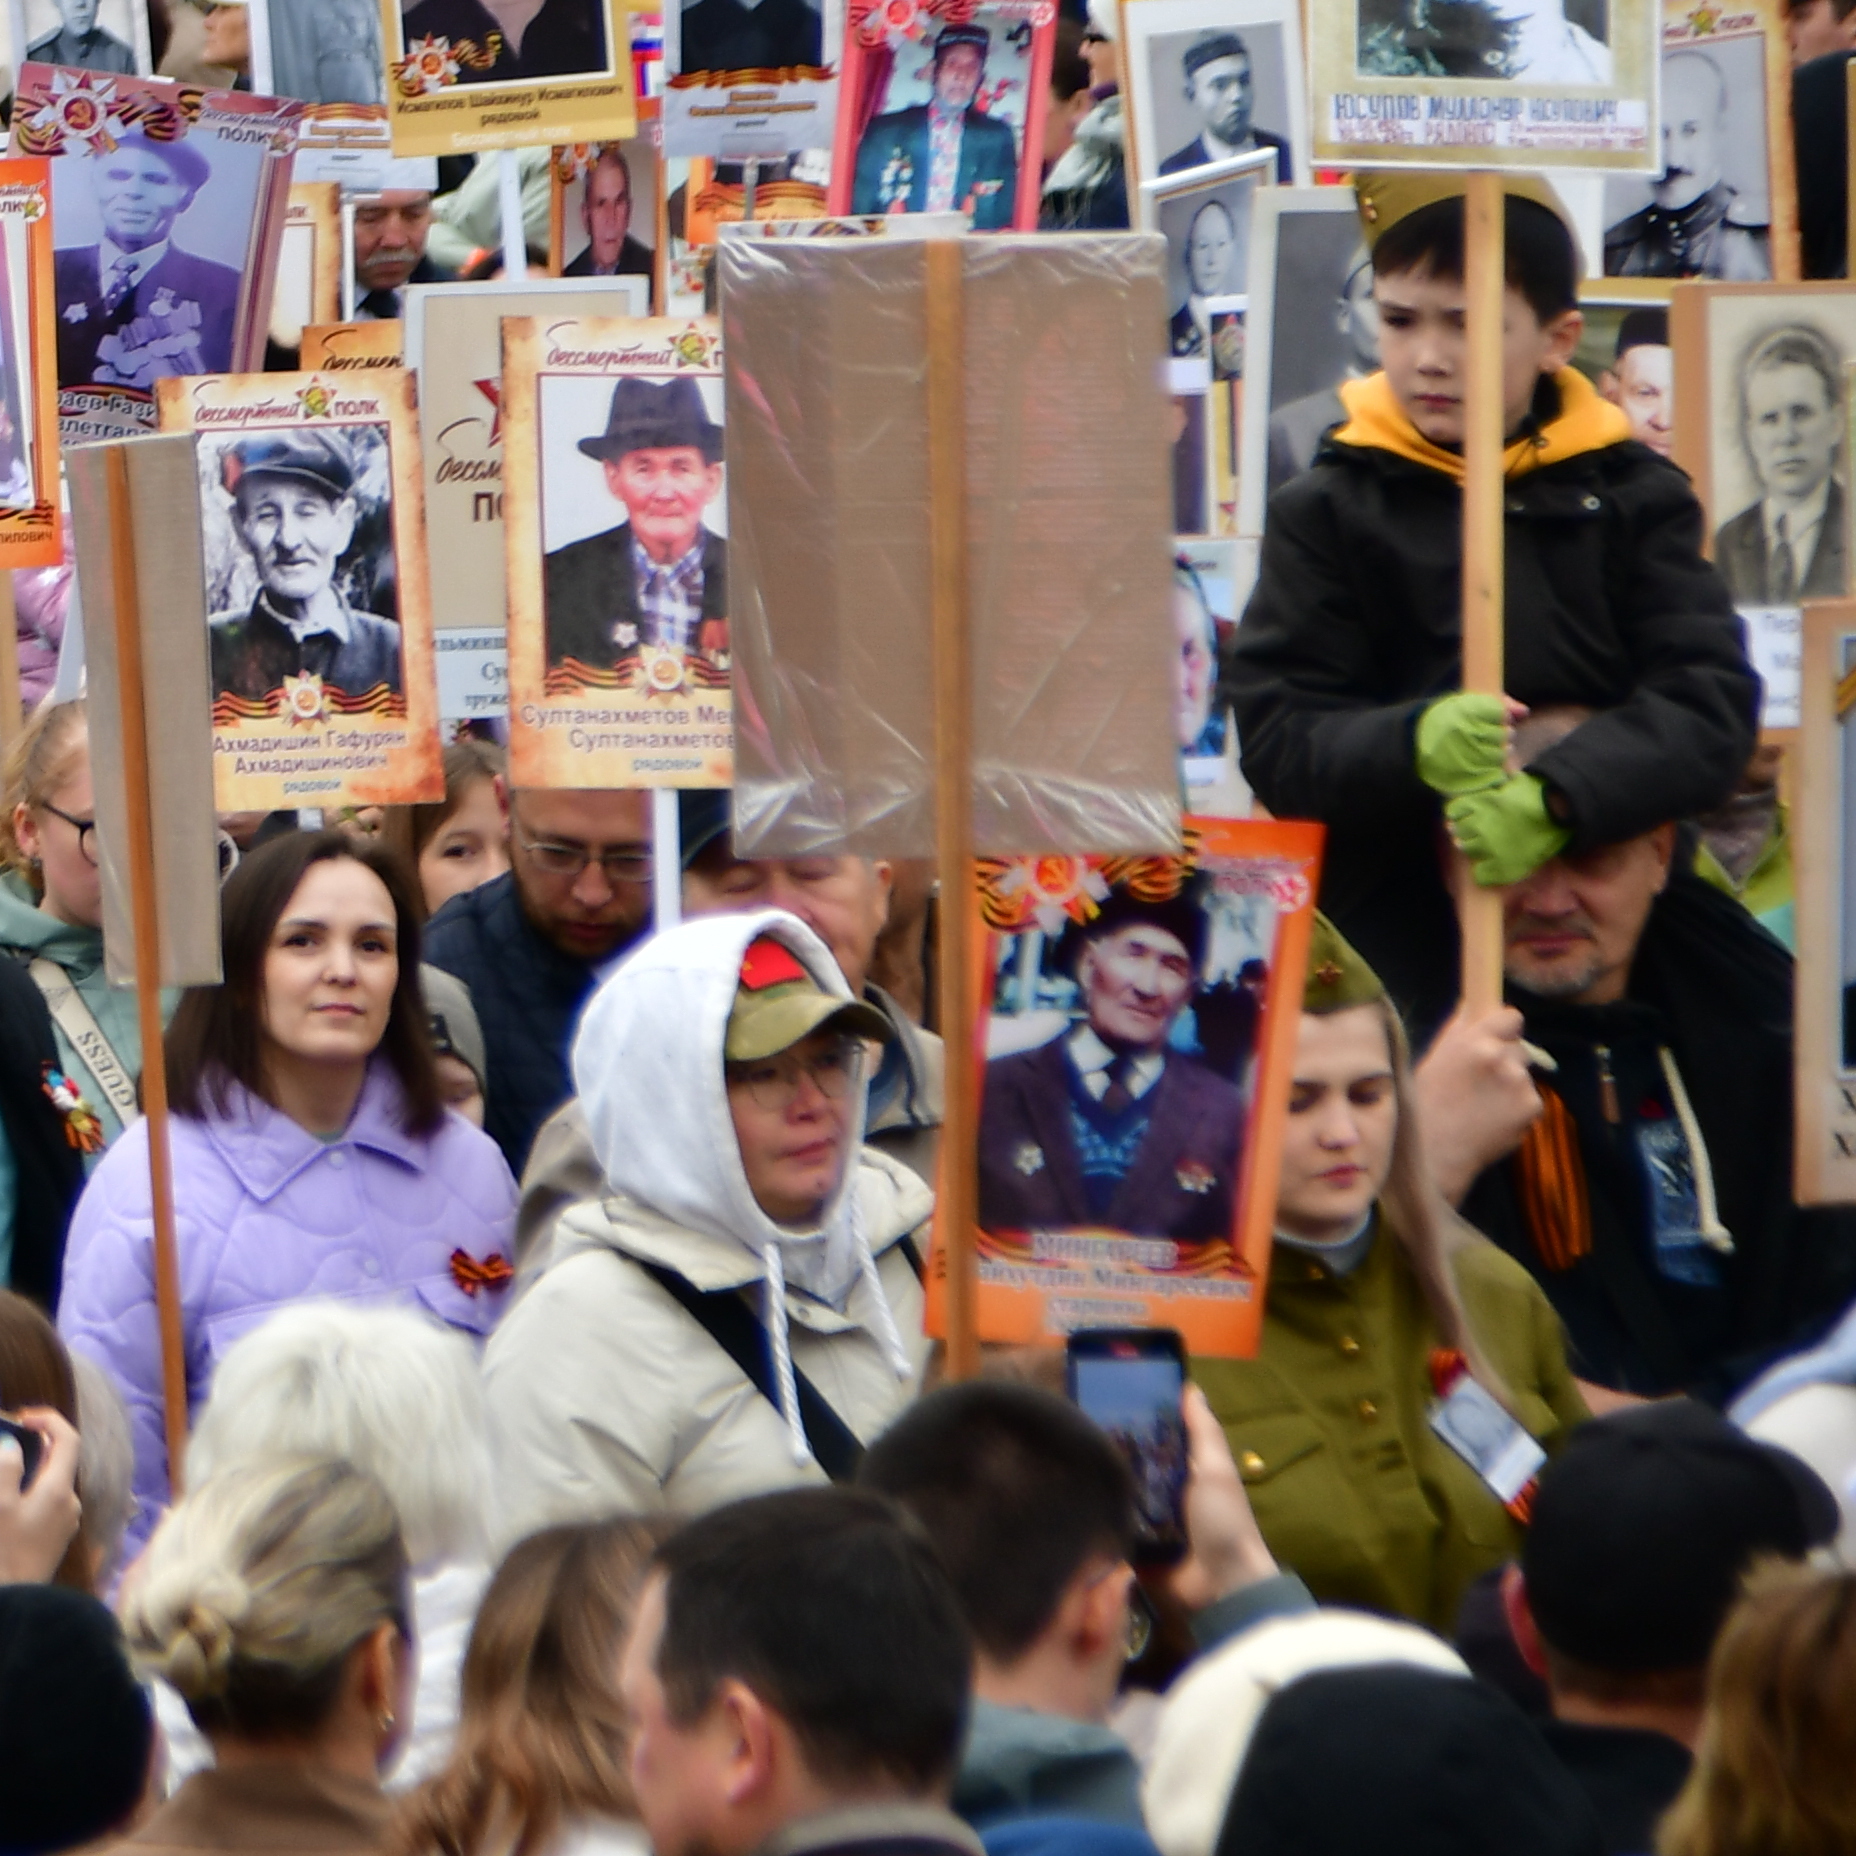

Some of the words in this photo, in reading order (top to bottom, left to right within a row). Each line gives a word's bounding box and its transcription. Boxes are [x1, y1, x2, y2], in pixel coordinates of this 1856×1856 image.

[480, 110, 540, 128] рядовой
[1334, 93, 1421, 121] ЮСУПОВ
[218, 127, 268, 146] ПОЛК
[546, 321, 673, 374] бессмертный
[192, 381, 302, 426] бессмертный
[334, 401, 379, 417] ПОЛК
[519, 704, 690, 730] Султанахметов
[213, 734, 321, 755] Ахмадишин
[234, 754, 388, 776] Ахмадишинович
[283, 778, 342, 795] рядовой
[1032, 1234, 1177, 1268] МИНГАРЕЕВ
